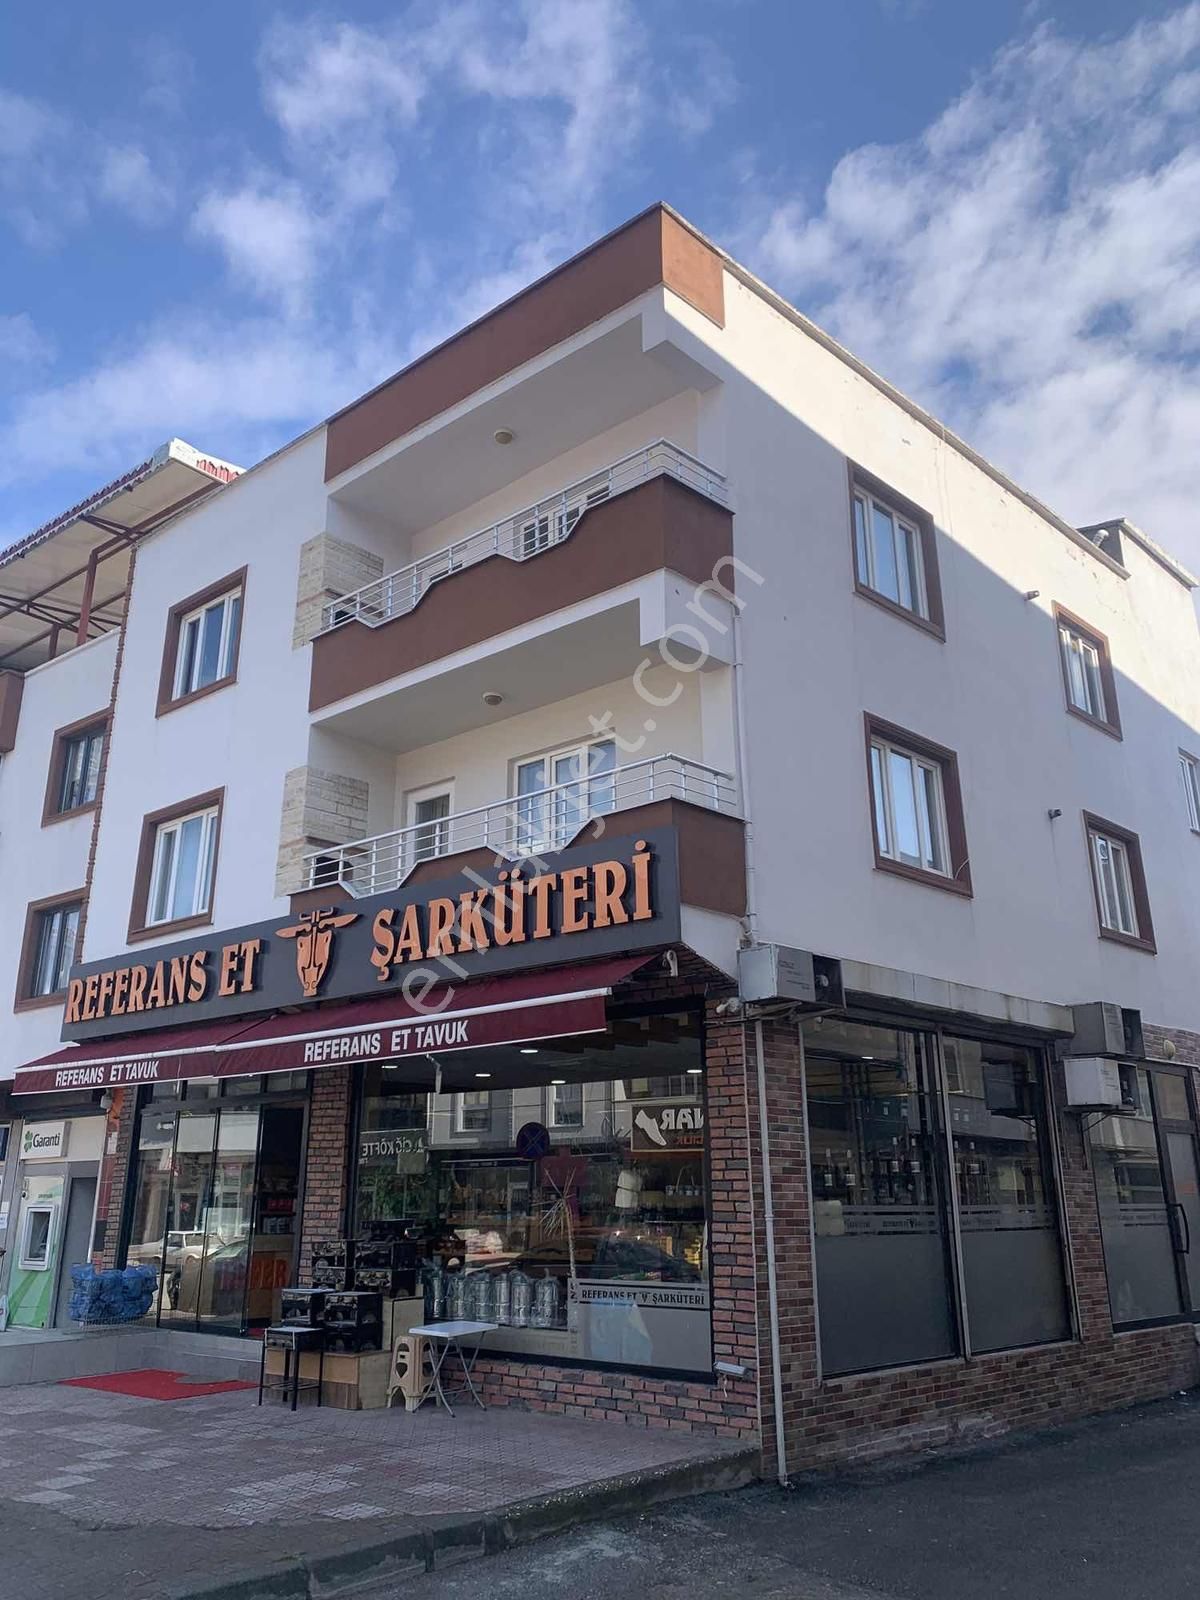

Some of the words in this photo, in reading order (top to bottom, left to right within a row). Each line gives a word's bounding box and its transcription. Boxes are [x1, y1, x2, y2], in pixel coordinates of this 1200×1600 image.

[64, 950, 207, 1024] REFERANS
[218, 938, 261, 996] ET
[370, 839, 653, 981] ŞARKÜTERİ
[304, 1033, 381, 1063] REFERANS
[391, 1028, 412, 1052] ET
[415, 1020, 469, 1049] TAVUK
[55, 1067, 104, 1087] REFERANS
[110, 1064, 125, 1082] ET
[125, 1061, 160, 1080] TAVUK
[33, 1133, 61, 1148] Garanti
